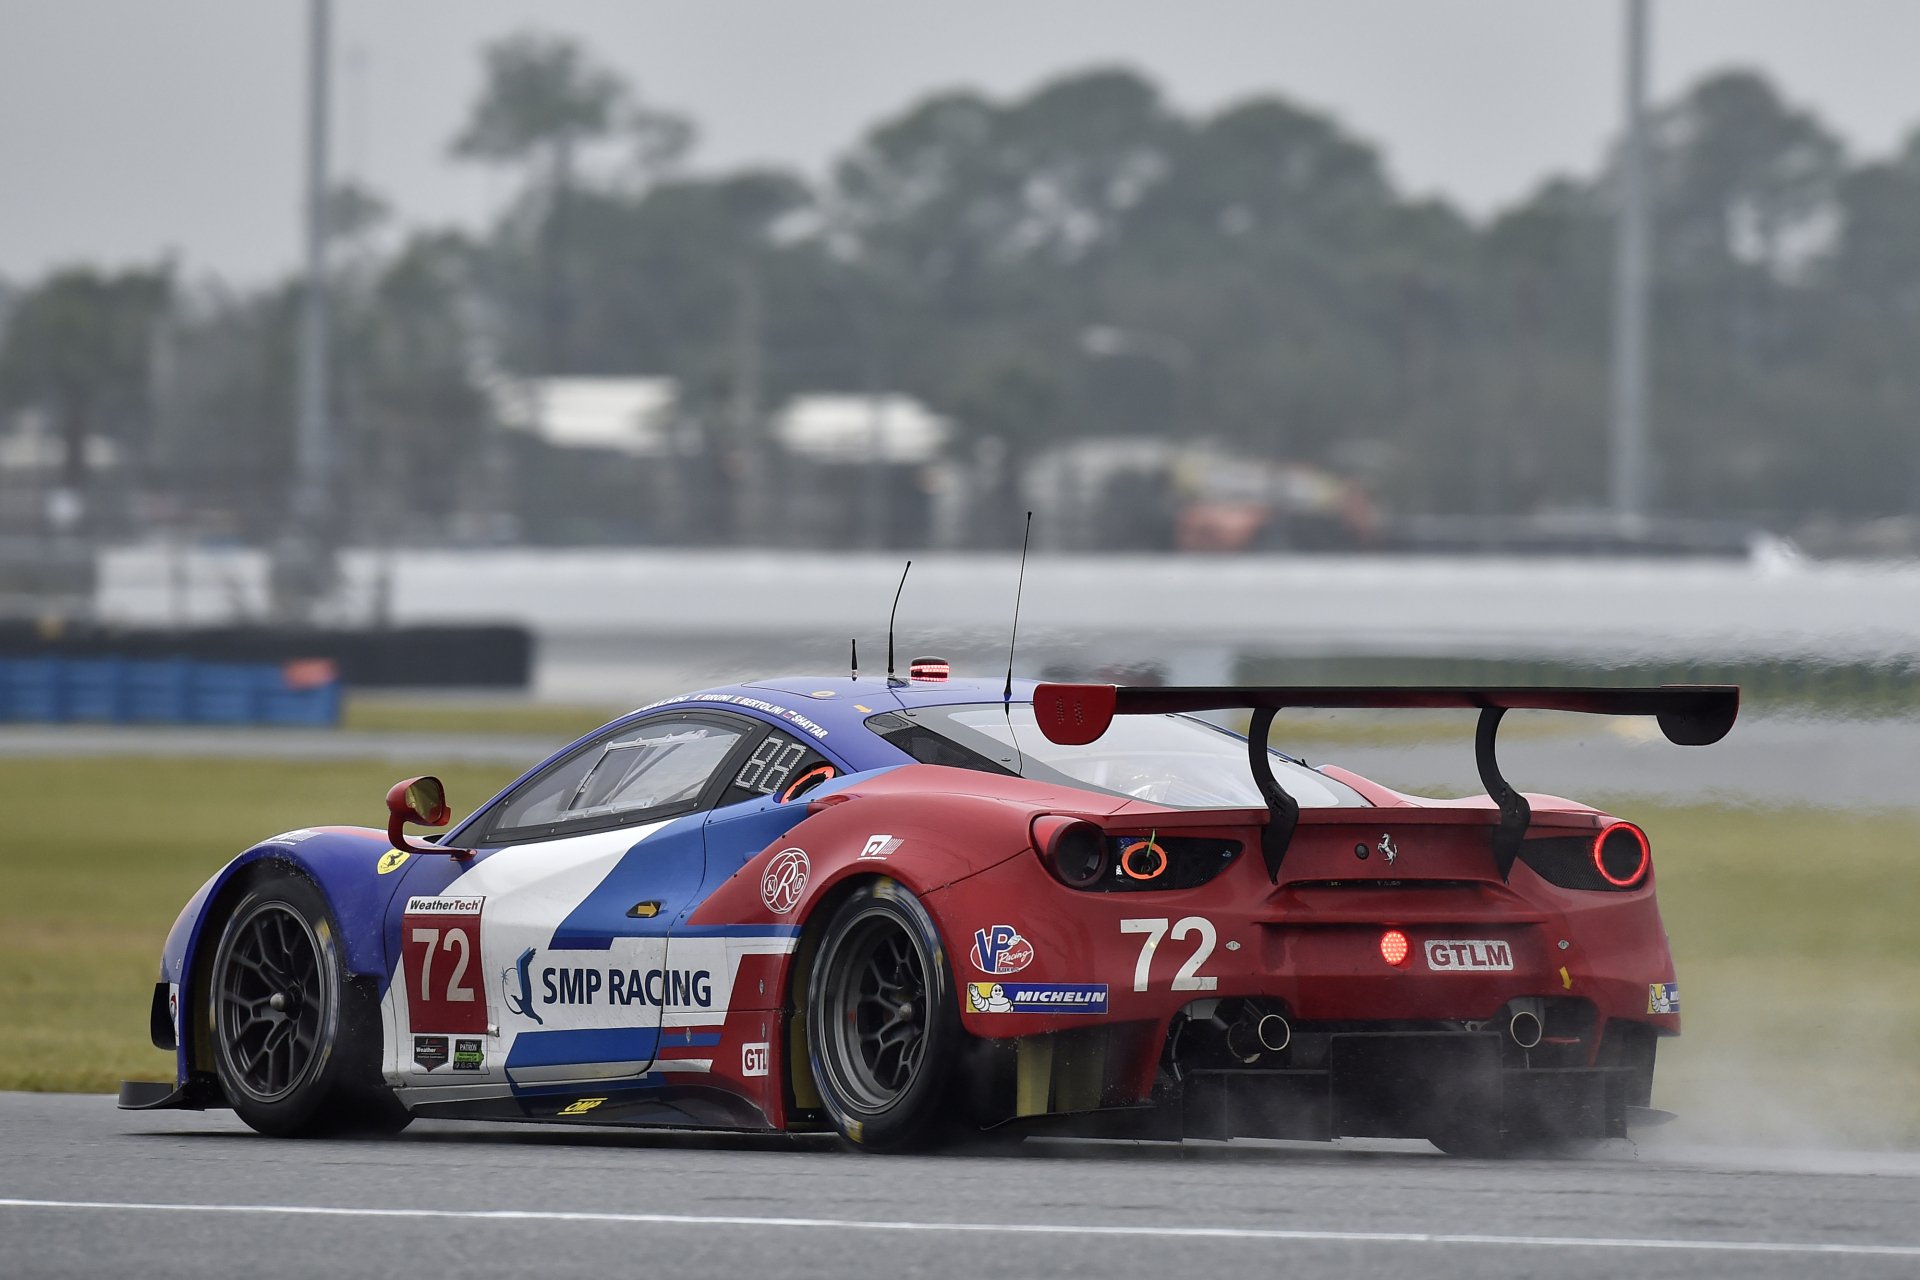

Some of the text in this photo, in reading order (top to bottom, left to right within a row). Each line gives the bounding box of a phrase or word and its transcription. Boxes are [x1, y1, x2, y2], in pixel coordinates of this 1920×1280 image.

[741, 697, 786, 715] BERTOLINI
[791, 713, 829, 739] SHAYTAR
[410, 900, 479, 910] WeatherTech
[412, 927, 475, 1002] 72
[975, 925, 1033, 973] VP Racing
[1120, 916, 1218, 992] 72
[1430, 944, 1510, 966] GTLM
[542, 967, 712, 1007] SMP RACING
[1014, 990, 1106, 1003] MICHELIN
